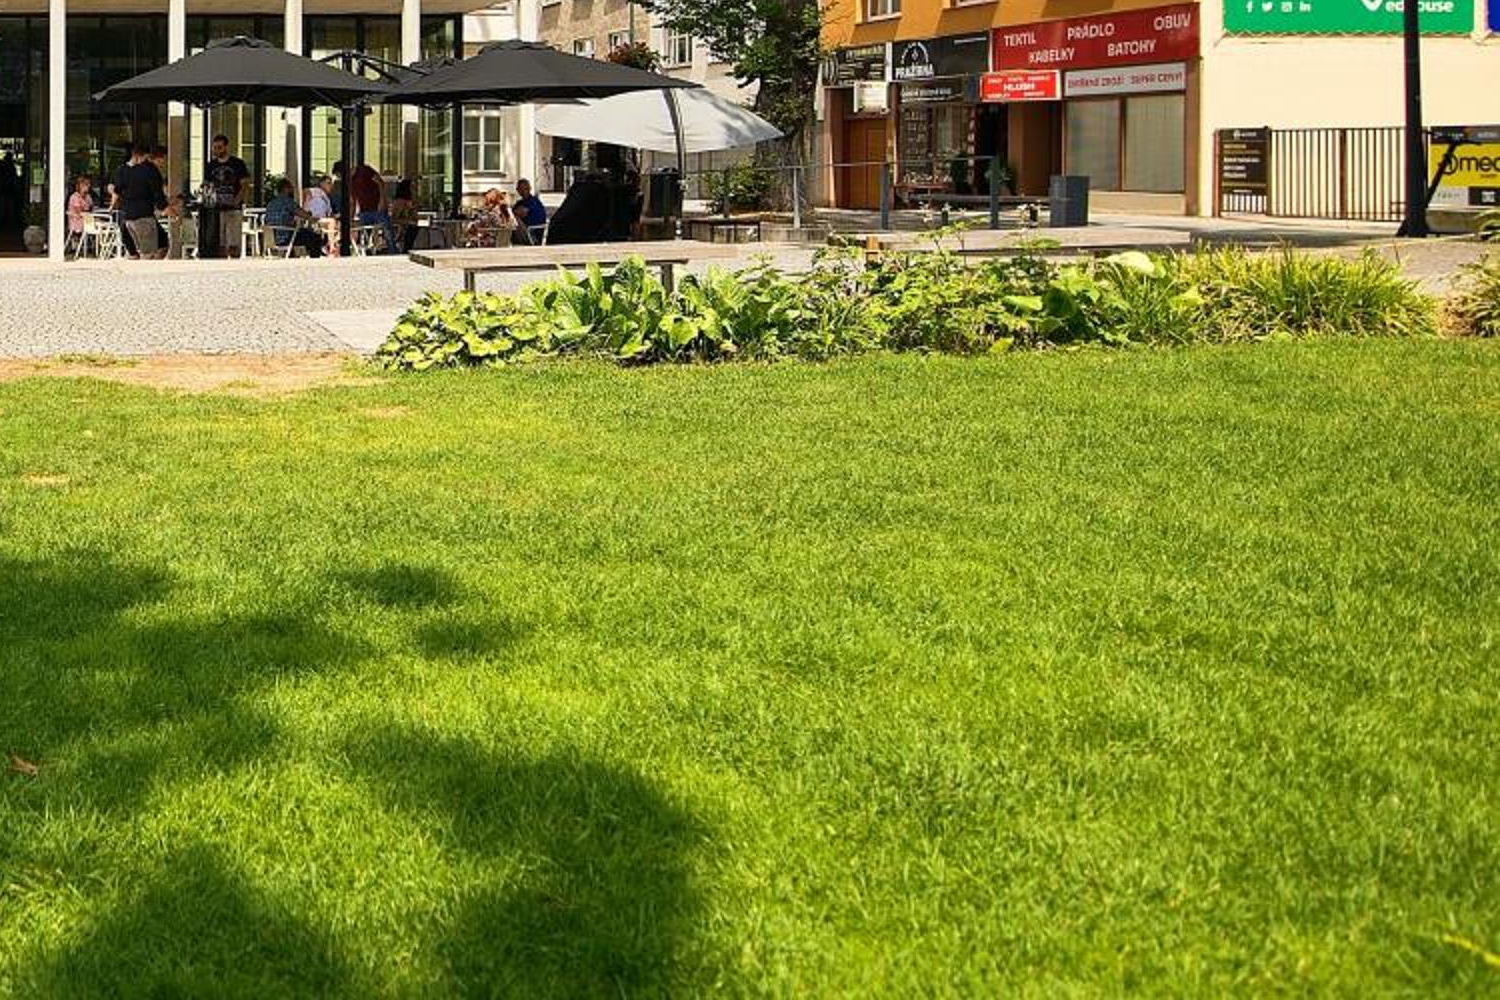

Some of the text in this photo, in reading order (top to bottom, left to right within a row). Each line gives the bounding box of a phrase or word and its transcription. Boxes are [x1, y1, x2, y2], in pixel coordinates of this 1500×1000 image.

[1153, 13, 1191, 31] OBUV
[1004, 32, 1036, 47] TEXTIL
[1028, 39, 1156, 63] KABELKY BATOHY
